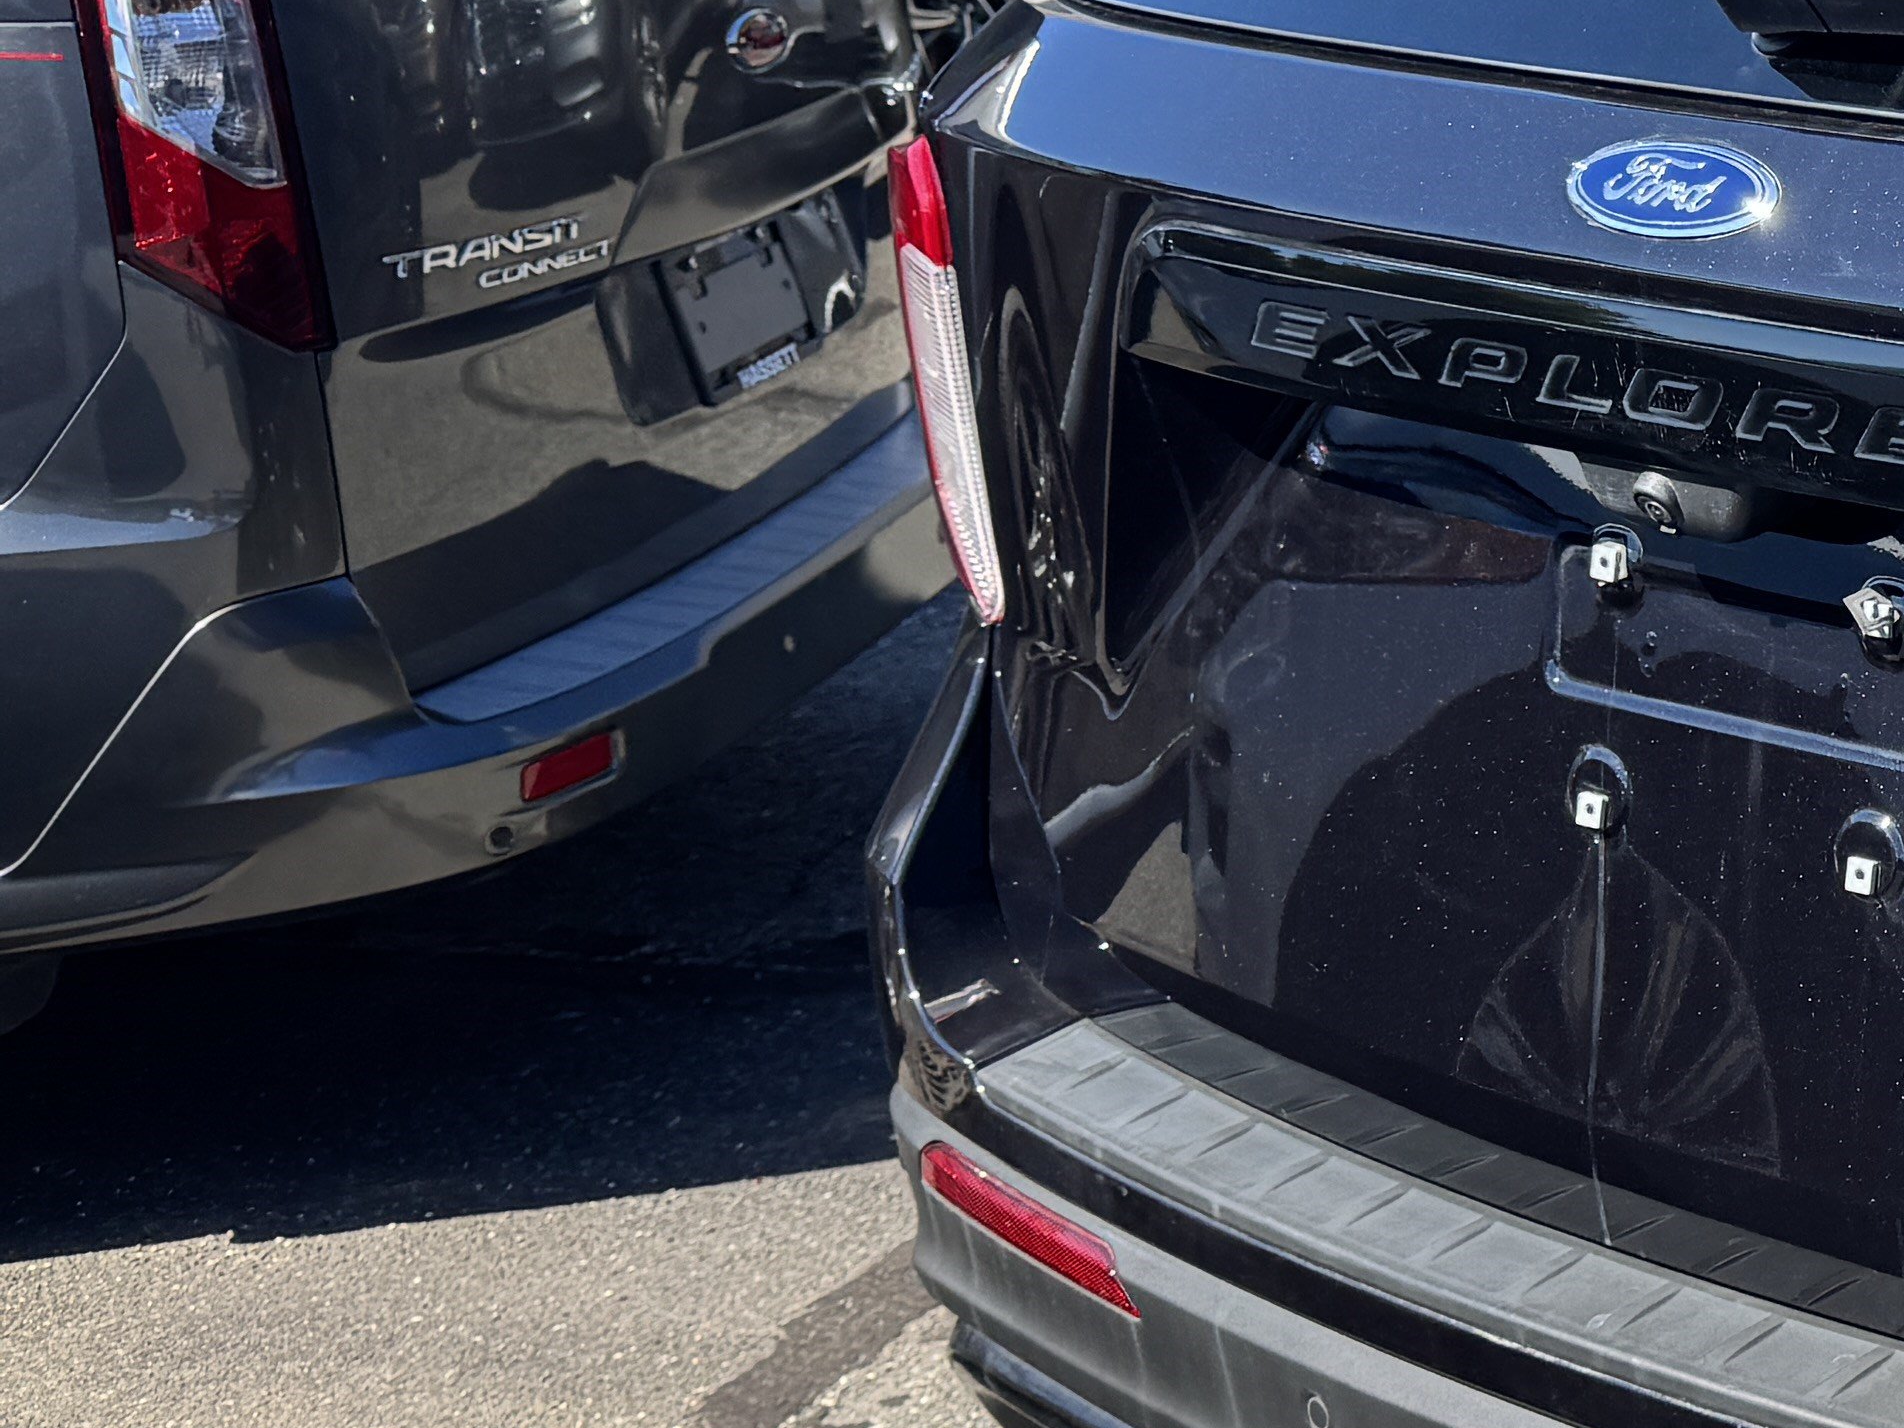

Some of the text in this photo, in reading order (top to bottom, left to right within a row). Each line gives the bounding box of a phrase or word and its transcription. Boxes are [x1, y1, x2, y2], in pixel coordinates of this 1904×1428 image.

[1602, 153, 1728, 214] Ford
[382, 217, 582, 278] TRANSIT
[478, 239, 609, 289] CONNECT
